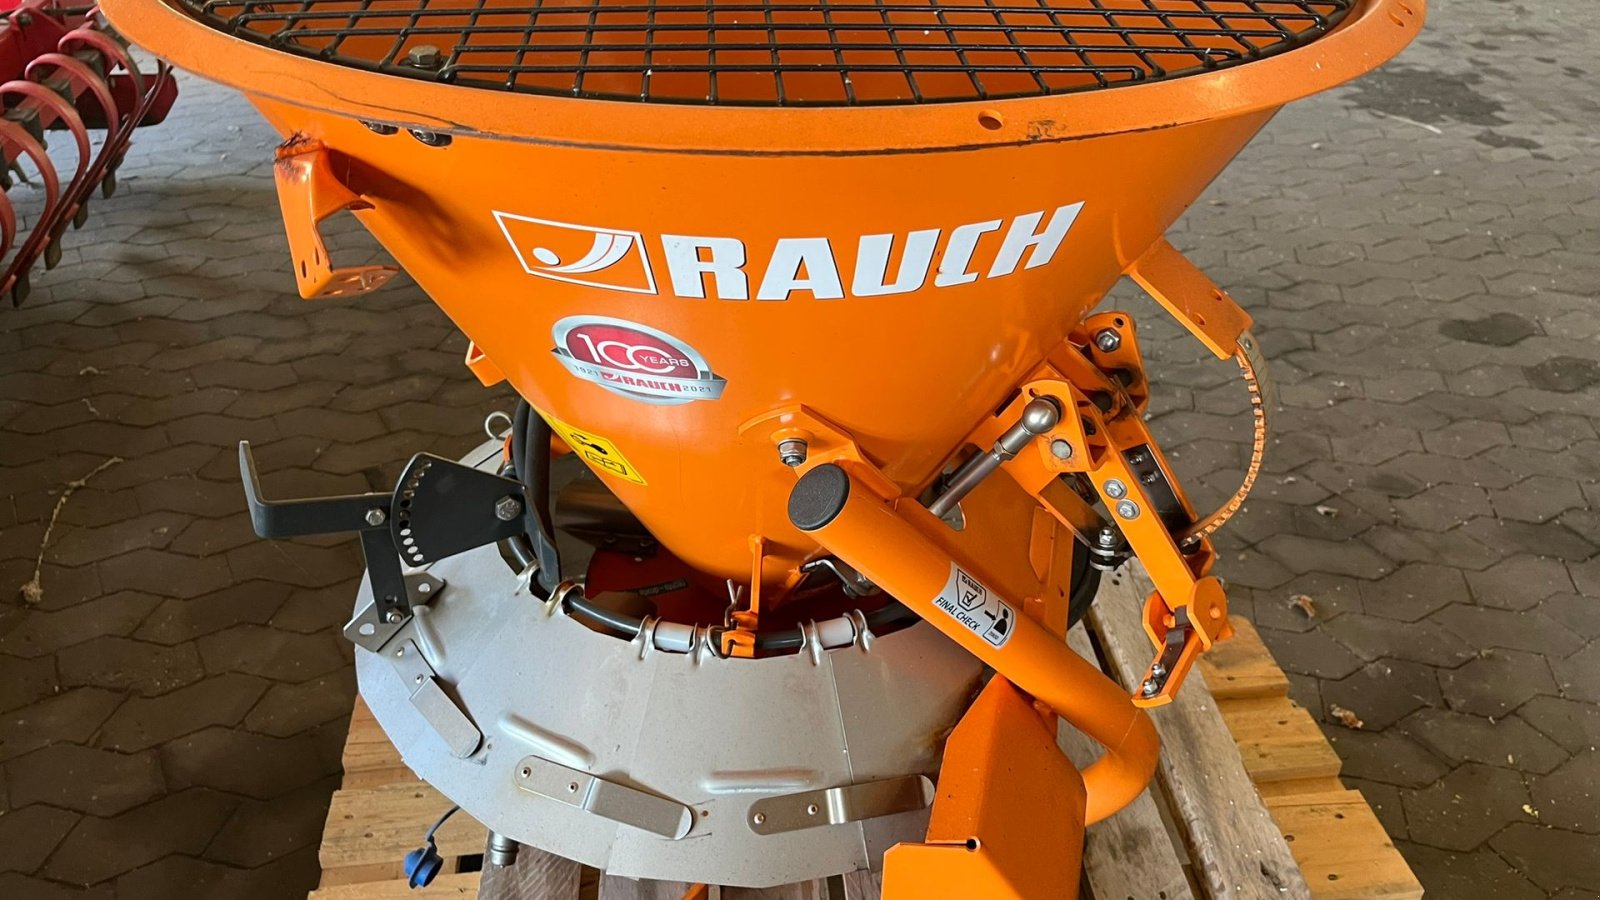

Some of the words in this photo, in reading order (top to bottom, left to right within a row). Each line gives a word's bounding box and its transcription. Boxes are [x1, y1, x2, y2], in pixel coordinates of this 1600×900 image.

[660, 201, 1085, 300] RAUCH
[576, 333, 676, 373] 100
[639, 354, 689, 367] YEARS
[573, 364, 599, 377] 1921
[622, 376, 682, 392] RAUCH
[683, 385, 712, 393] 2021
[935, 596, 956, 616] FINAL
[955, 611, 981, 631] CHECK
